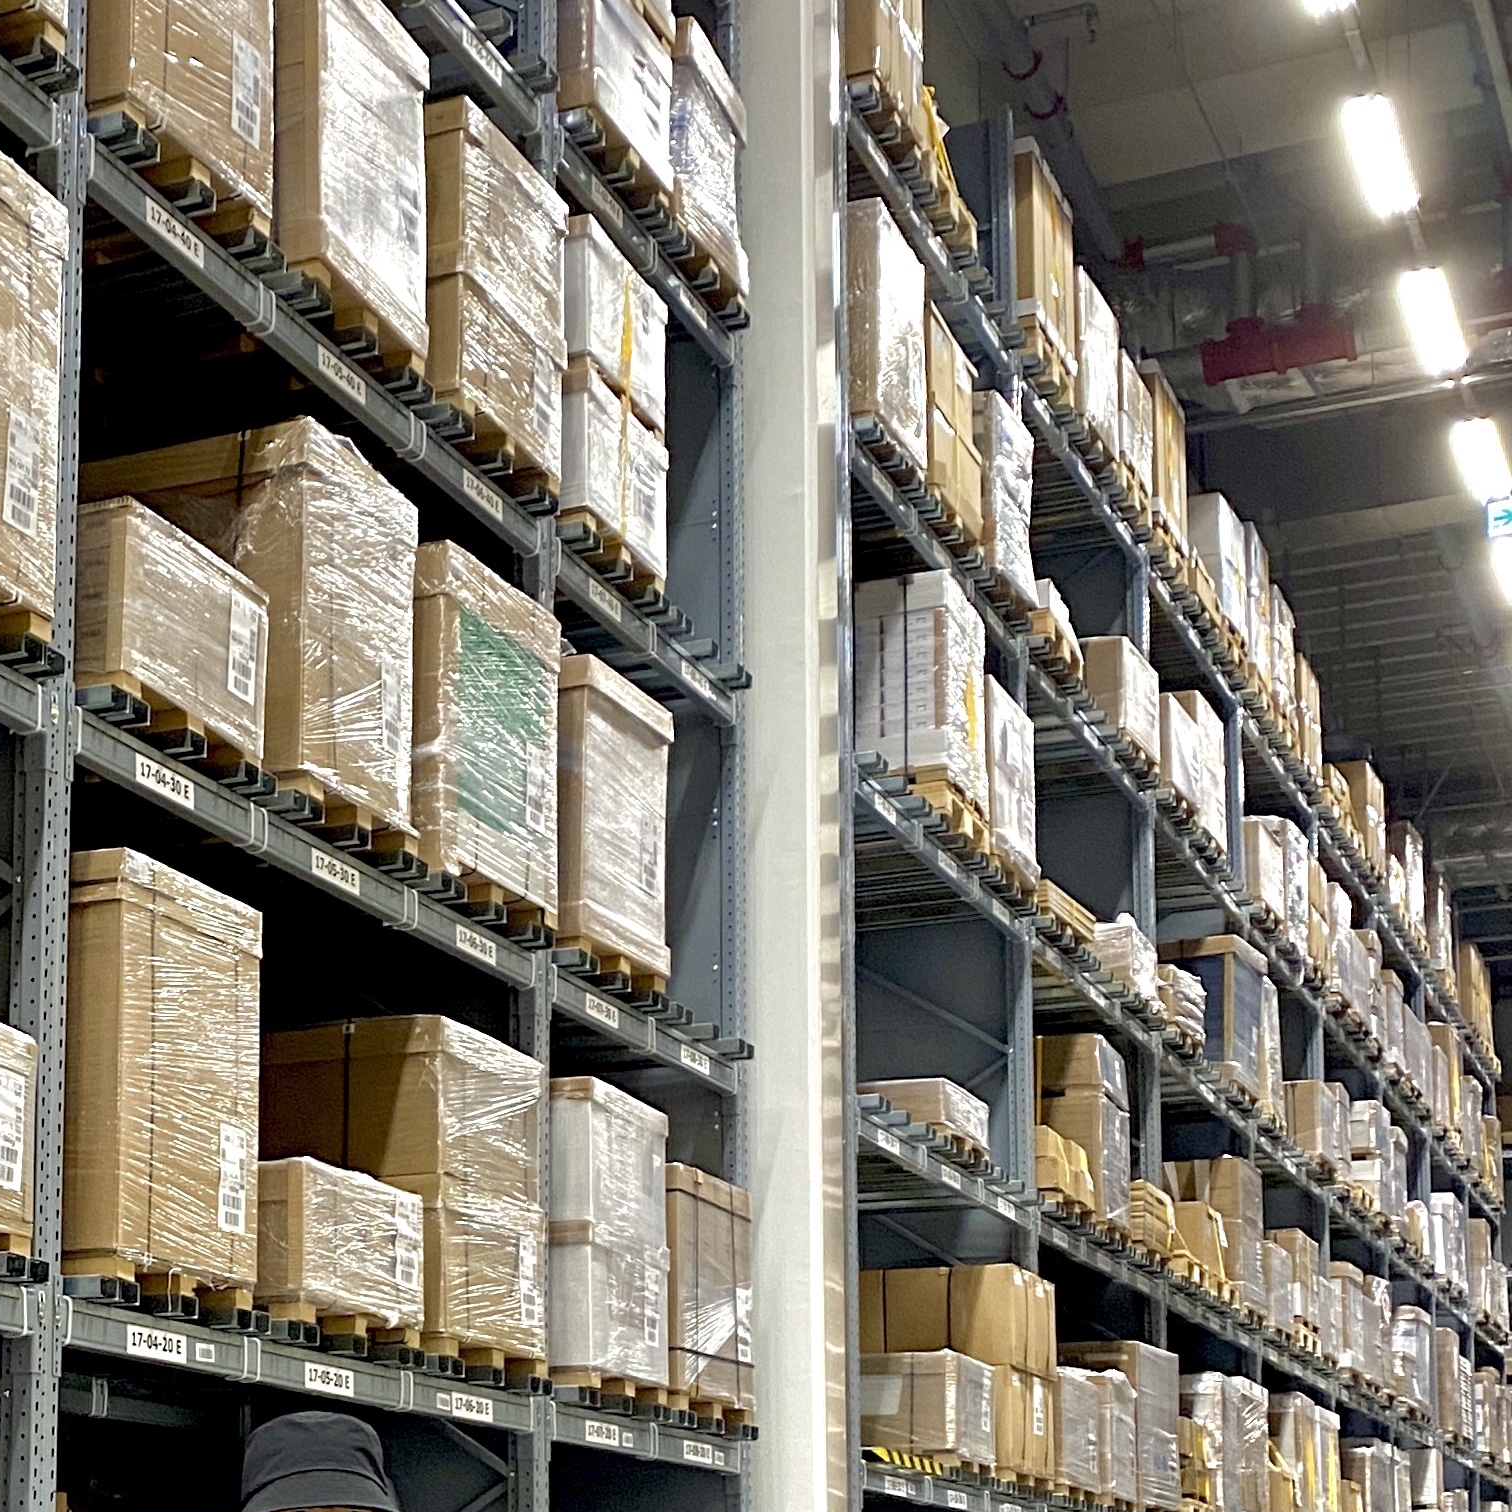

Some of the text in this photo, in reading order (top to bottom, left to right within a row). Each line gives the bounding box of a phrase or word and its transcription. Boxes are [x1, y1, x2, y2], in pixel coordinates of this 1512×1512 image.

[140, 762, 189, 800] 17-04-30 E
[351, 873, 356, 887] E
[132, 1331, 181, 1355] 17-04-20 E
[345, 1375, 350, 1390] E
